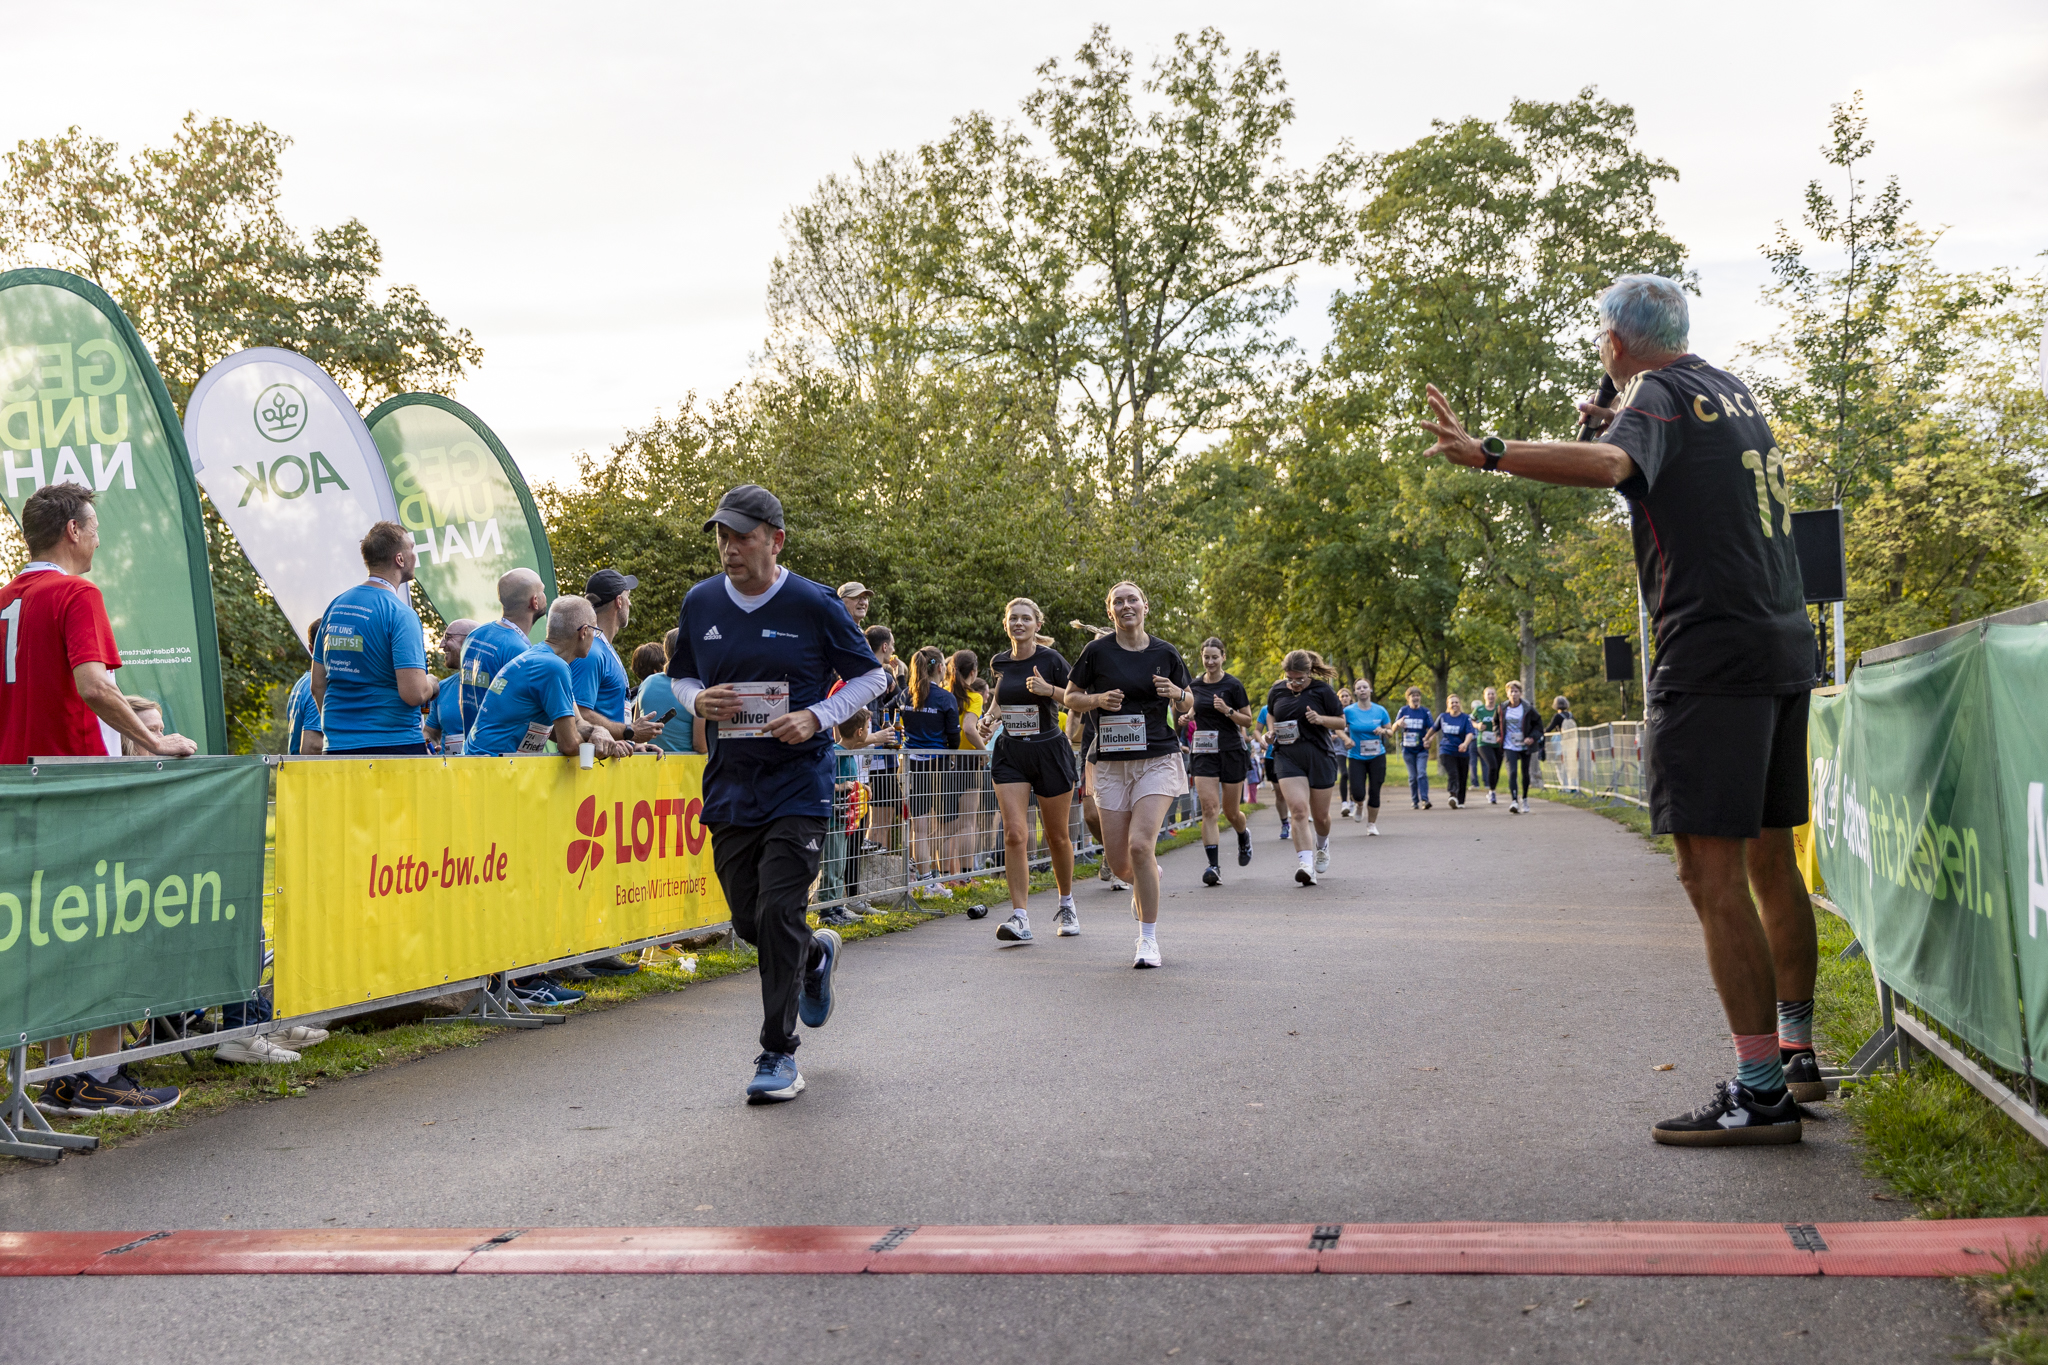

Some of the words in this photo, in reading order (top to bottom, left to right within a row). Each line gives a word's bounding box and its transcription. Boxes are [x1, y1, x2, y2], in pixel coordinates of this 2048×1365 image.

[339, 626, 352, 635] UNS
[327, 636, 359, 648] ÄUFT'S!
[731, 710, 770, 725] Oliver
[1102, 733, 1140, 744] Michelle
[614, 797, 707, 865] LOTTO
[369, 842, 508, 898] lotto-bw.de
[616, 873, 707, 906] Baden-Württemberg
